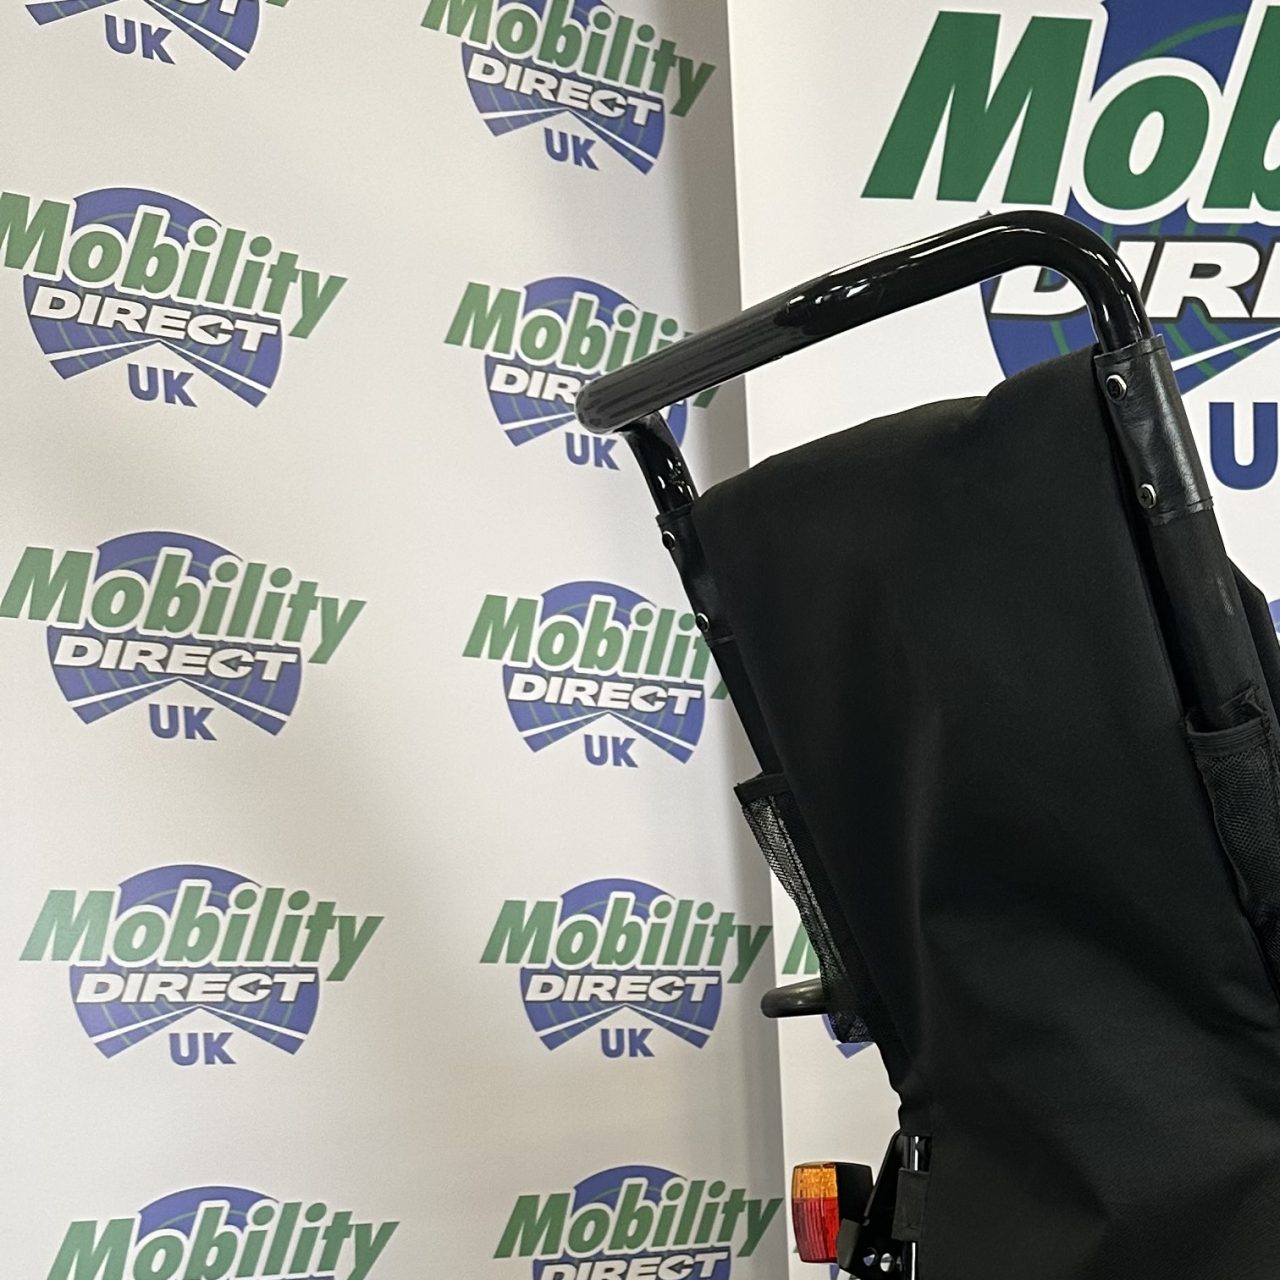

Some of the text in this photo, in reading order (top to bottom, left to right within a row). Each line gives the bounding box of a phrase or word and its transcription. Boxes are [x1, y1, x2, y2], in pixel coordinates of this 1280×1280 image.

[105, 14, 175, 65] UK
[467, 54, 661, 126] DIRECT
[544, 127, 599, 171] UK
[0, 192, 348, 339] Mobility
[31, 286, 279, 351] DIRECT
[128, 363, 197, 408] UK
[565, 432, 620, 471] UK
[0, 547, 367, 664] Mobility
[54, 635, 298, 681] DIRECT
[508, 673, 703, 714] DIRECT
[149, 703, 217, 741] UK
[584, 734, 638, 768] UK
[19, 886, 384, 981] Mobility
[480, 898, 773, 984] Mobility
[76, 973, 315, 1003] DIRECT
[525, 975, 720, 1002] DIRECT
[169, 1032, 236, 1066] UK
[600, 1028, 655, 1058] UK
[493, 1180, 784, 1259] Mobility
